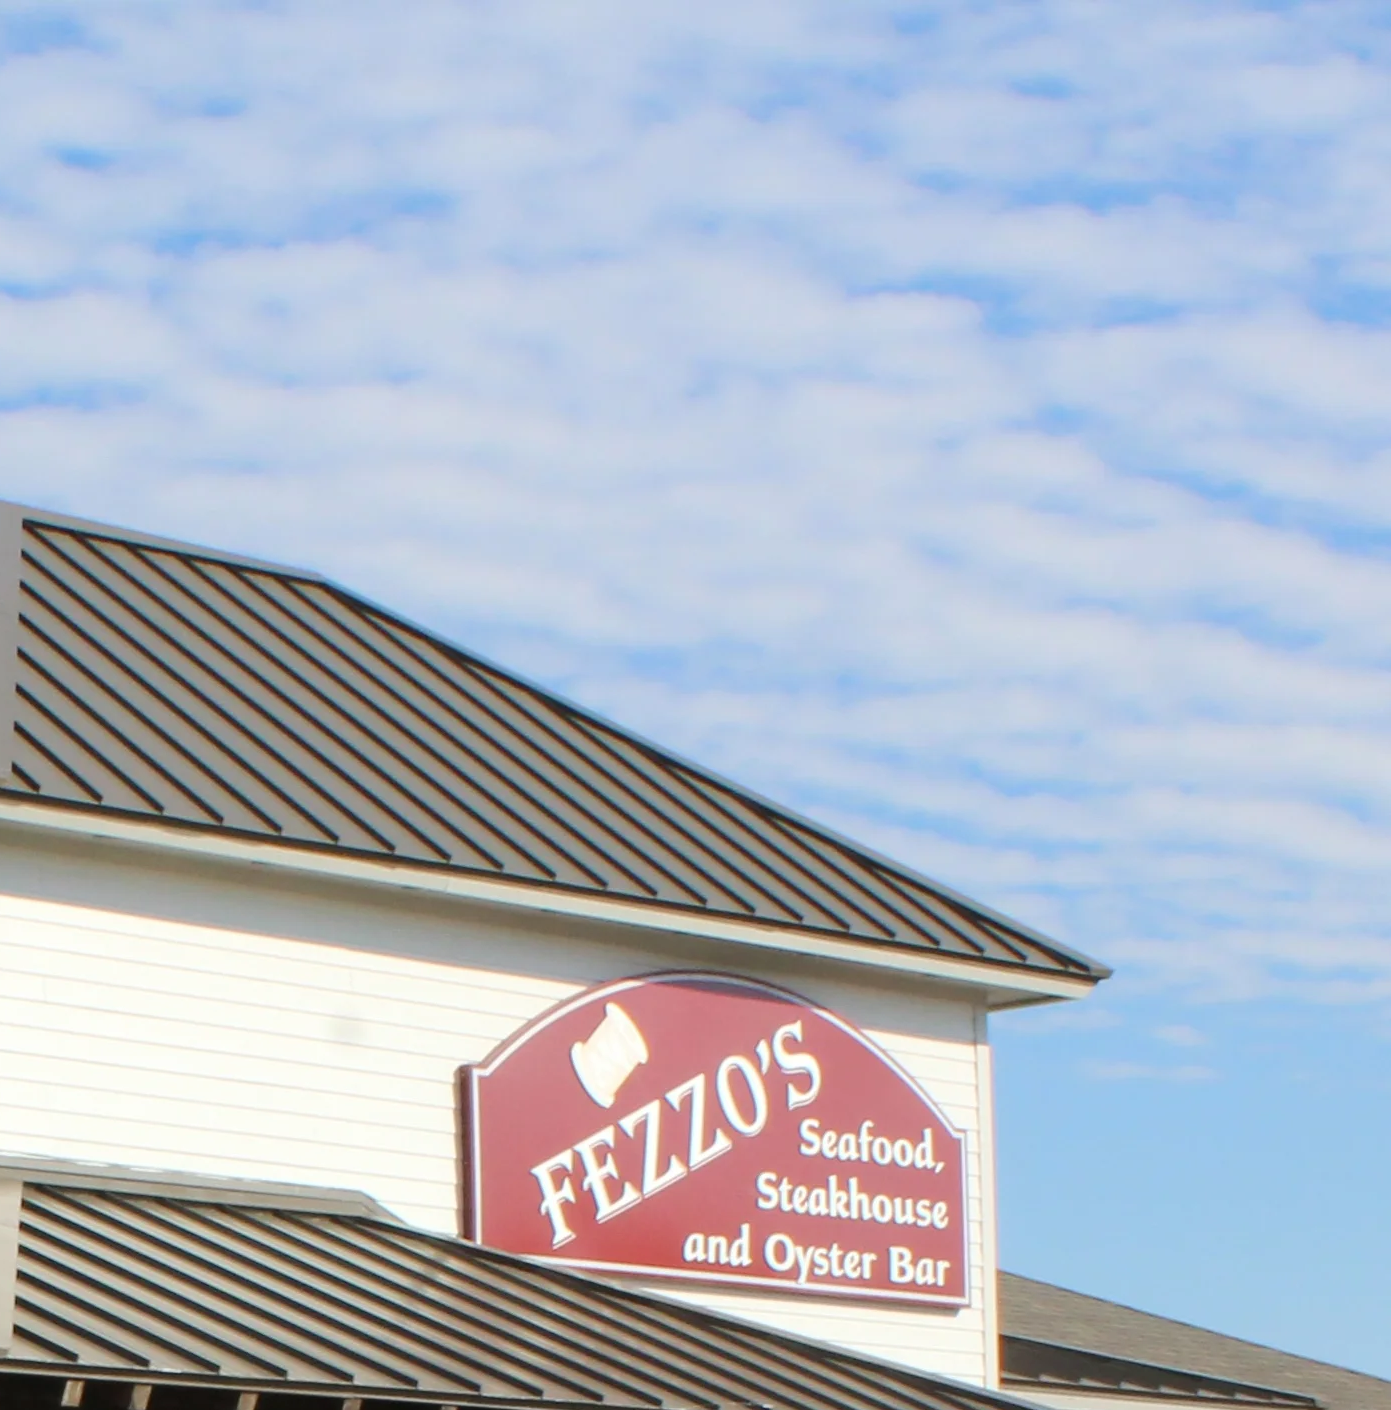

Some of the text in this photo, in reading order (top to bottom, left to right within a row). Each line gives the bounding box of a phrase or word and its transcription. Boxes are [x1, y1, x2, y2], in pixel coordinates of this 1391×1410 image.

[530, 1020, 822, 1250] FEZZO'S
[799, 1118, 946, 1174] Seafood,
[756, 1172, 949, 1229] Steakhouse
[683, 1223, 951, 1288] and Oyster Bar
